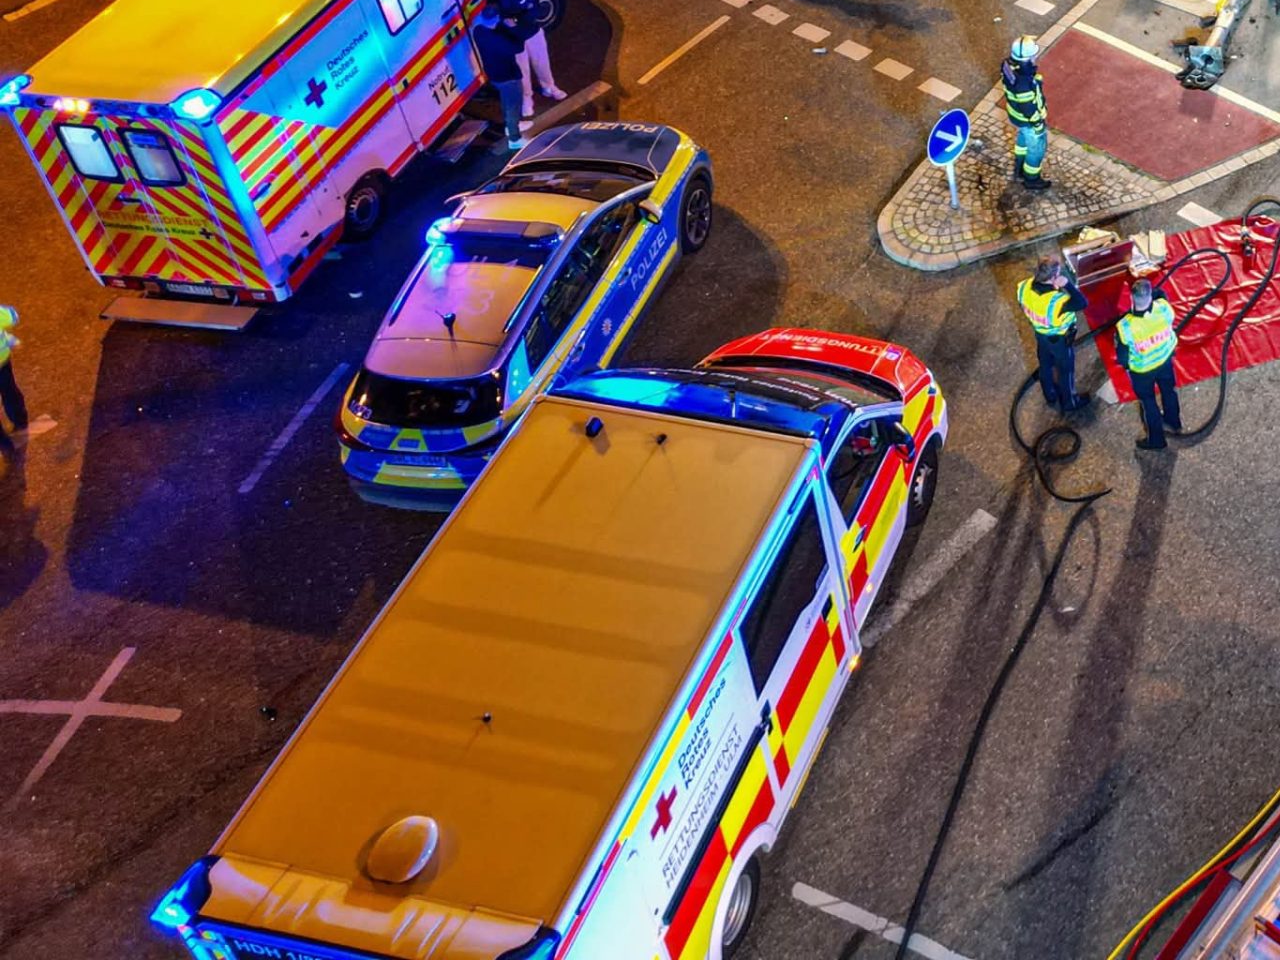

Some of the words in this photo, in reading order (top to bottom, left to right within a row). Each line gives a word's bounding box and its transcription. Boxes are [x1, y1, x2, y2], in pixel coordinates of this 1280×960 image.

[326, 29, 369, 71] Deutsches
[330, 56, 355, 81] Rotes
[335, 65, 359, 90] Kreuz
[431, 73, 458, 106] 112
[581, 122, 659, 134] POLIZEI
[630, 230, 669, 291] POLIZEI
[677, 677, 727, 768] Deutsches
[681, 727, 709, 778] Rotes
[685, 737, 713, 790] Kreuz
[661, 723, 739, 878] RETTUNGSDIENST
[665, 783, 719, 888] HEIDENHEIM
[722, 734, 744, 773] ULM
